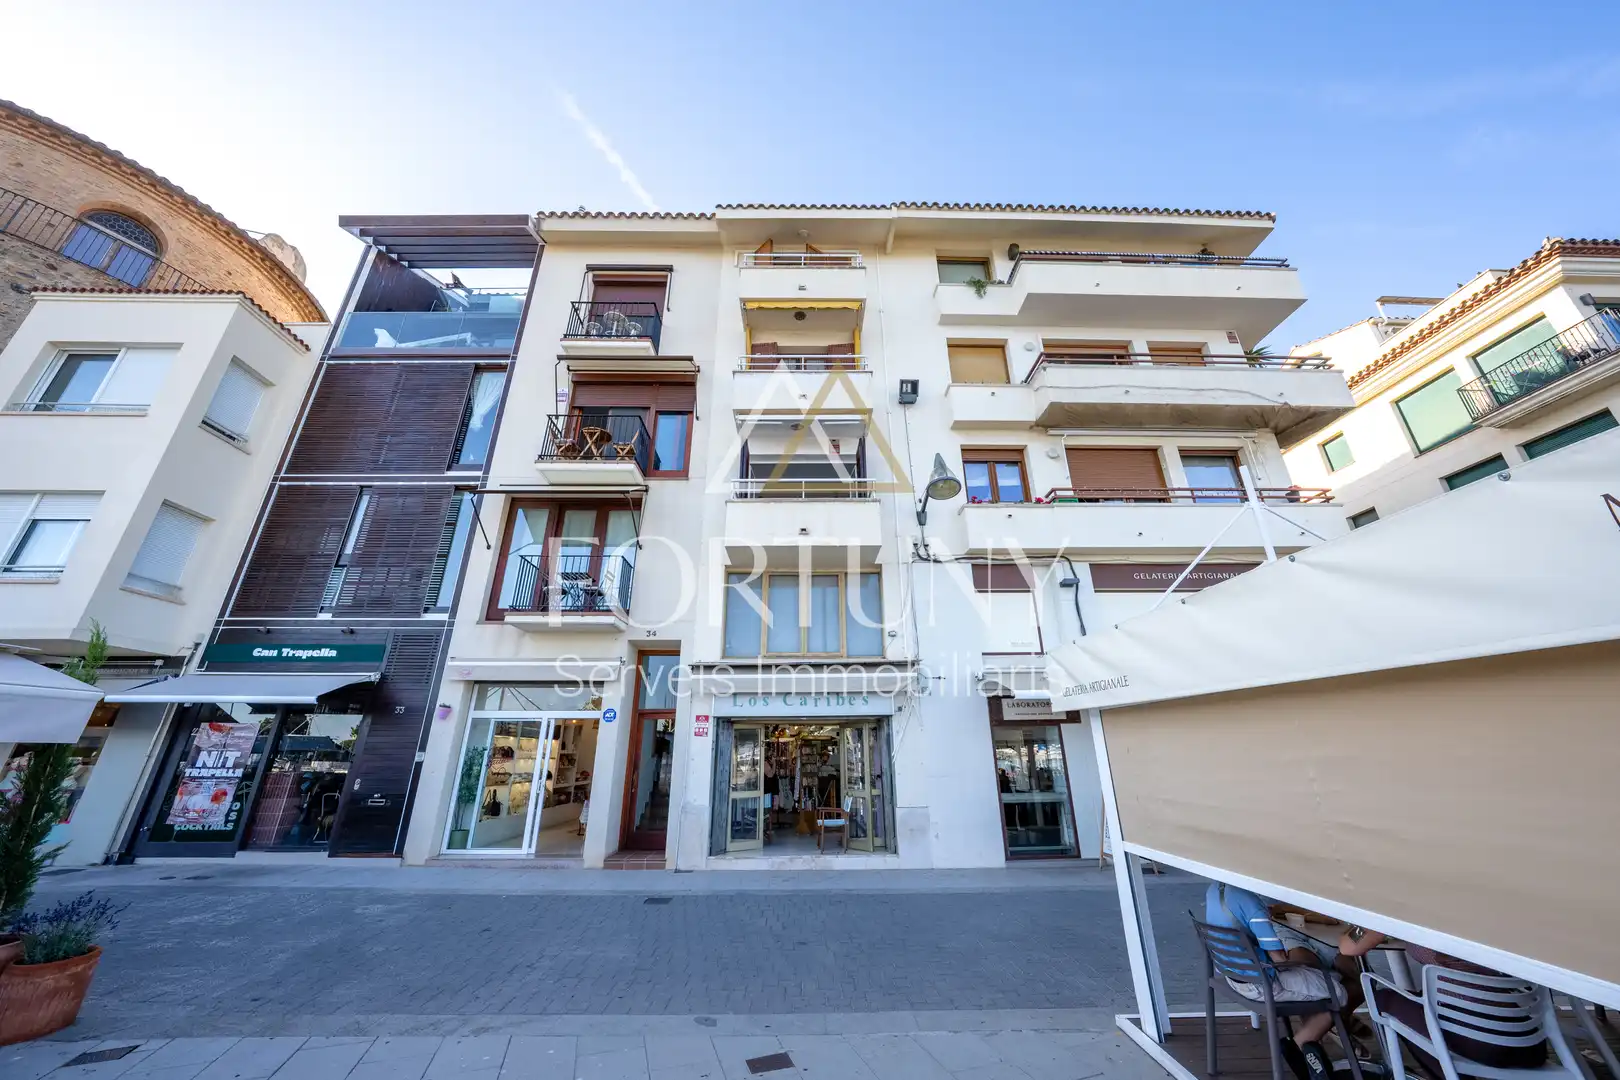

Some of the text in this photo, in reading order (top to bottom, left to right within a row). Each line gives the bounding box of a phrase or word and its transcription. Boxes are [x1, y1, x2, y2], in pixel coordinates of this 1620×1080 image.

[252, 648, 337, 660] Can Trapella
[1089, 675, 1129, 693] ARTIGIANALE
[732, 692, 869, 708] Los Caribes
[395, 706, 405, 714] 33
[195, 750, 241, 768] NIT
[184, 768, 244, 777] TRAPELLA
[174, 822, 235, 832] COCKTAILS
